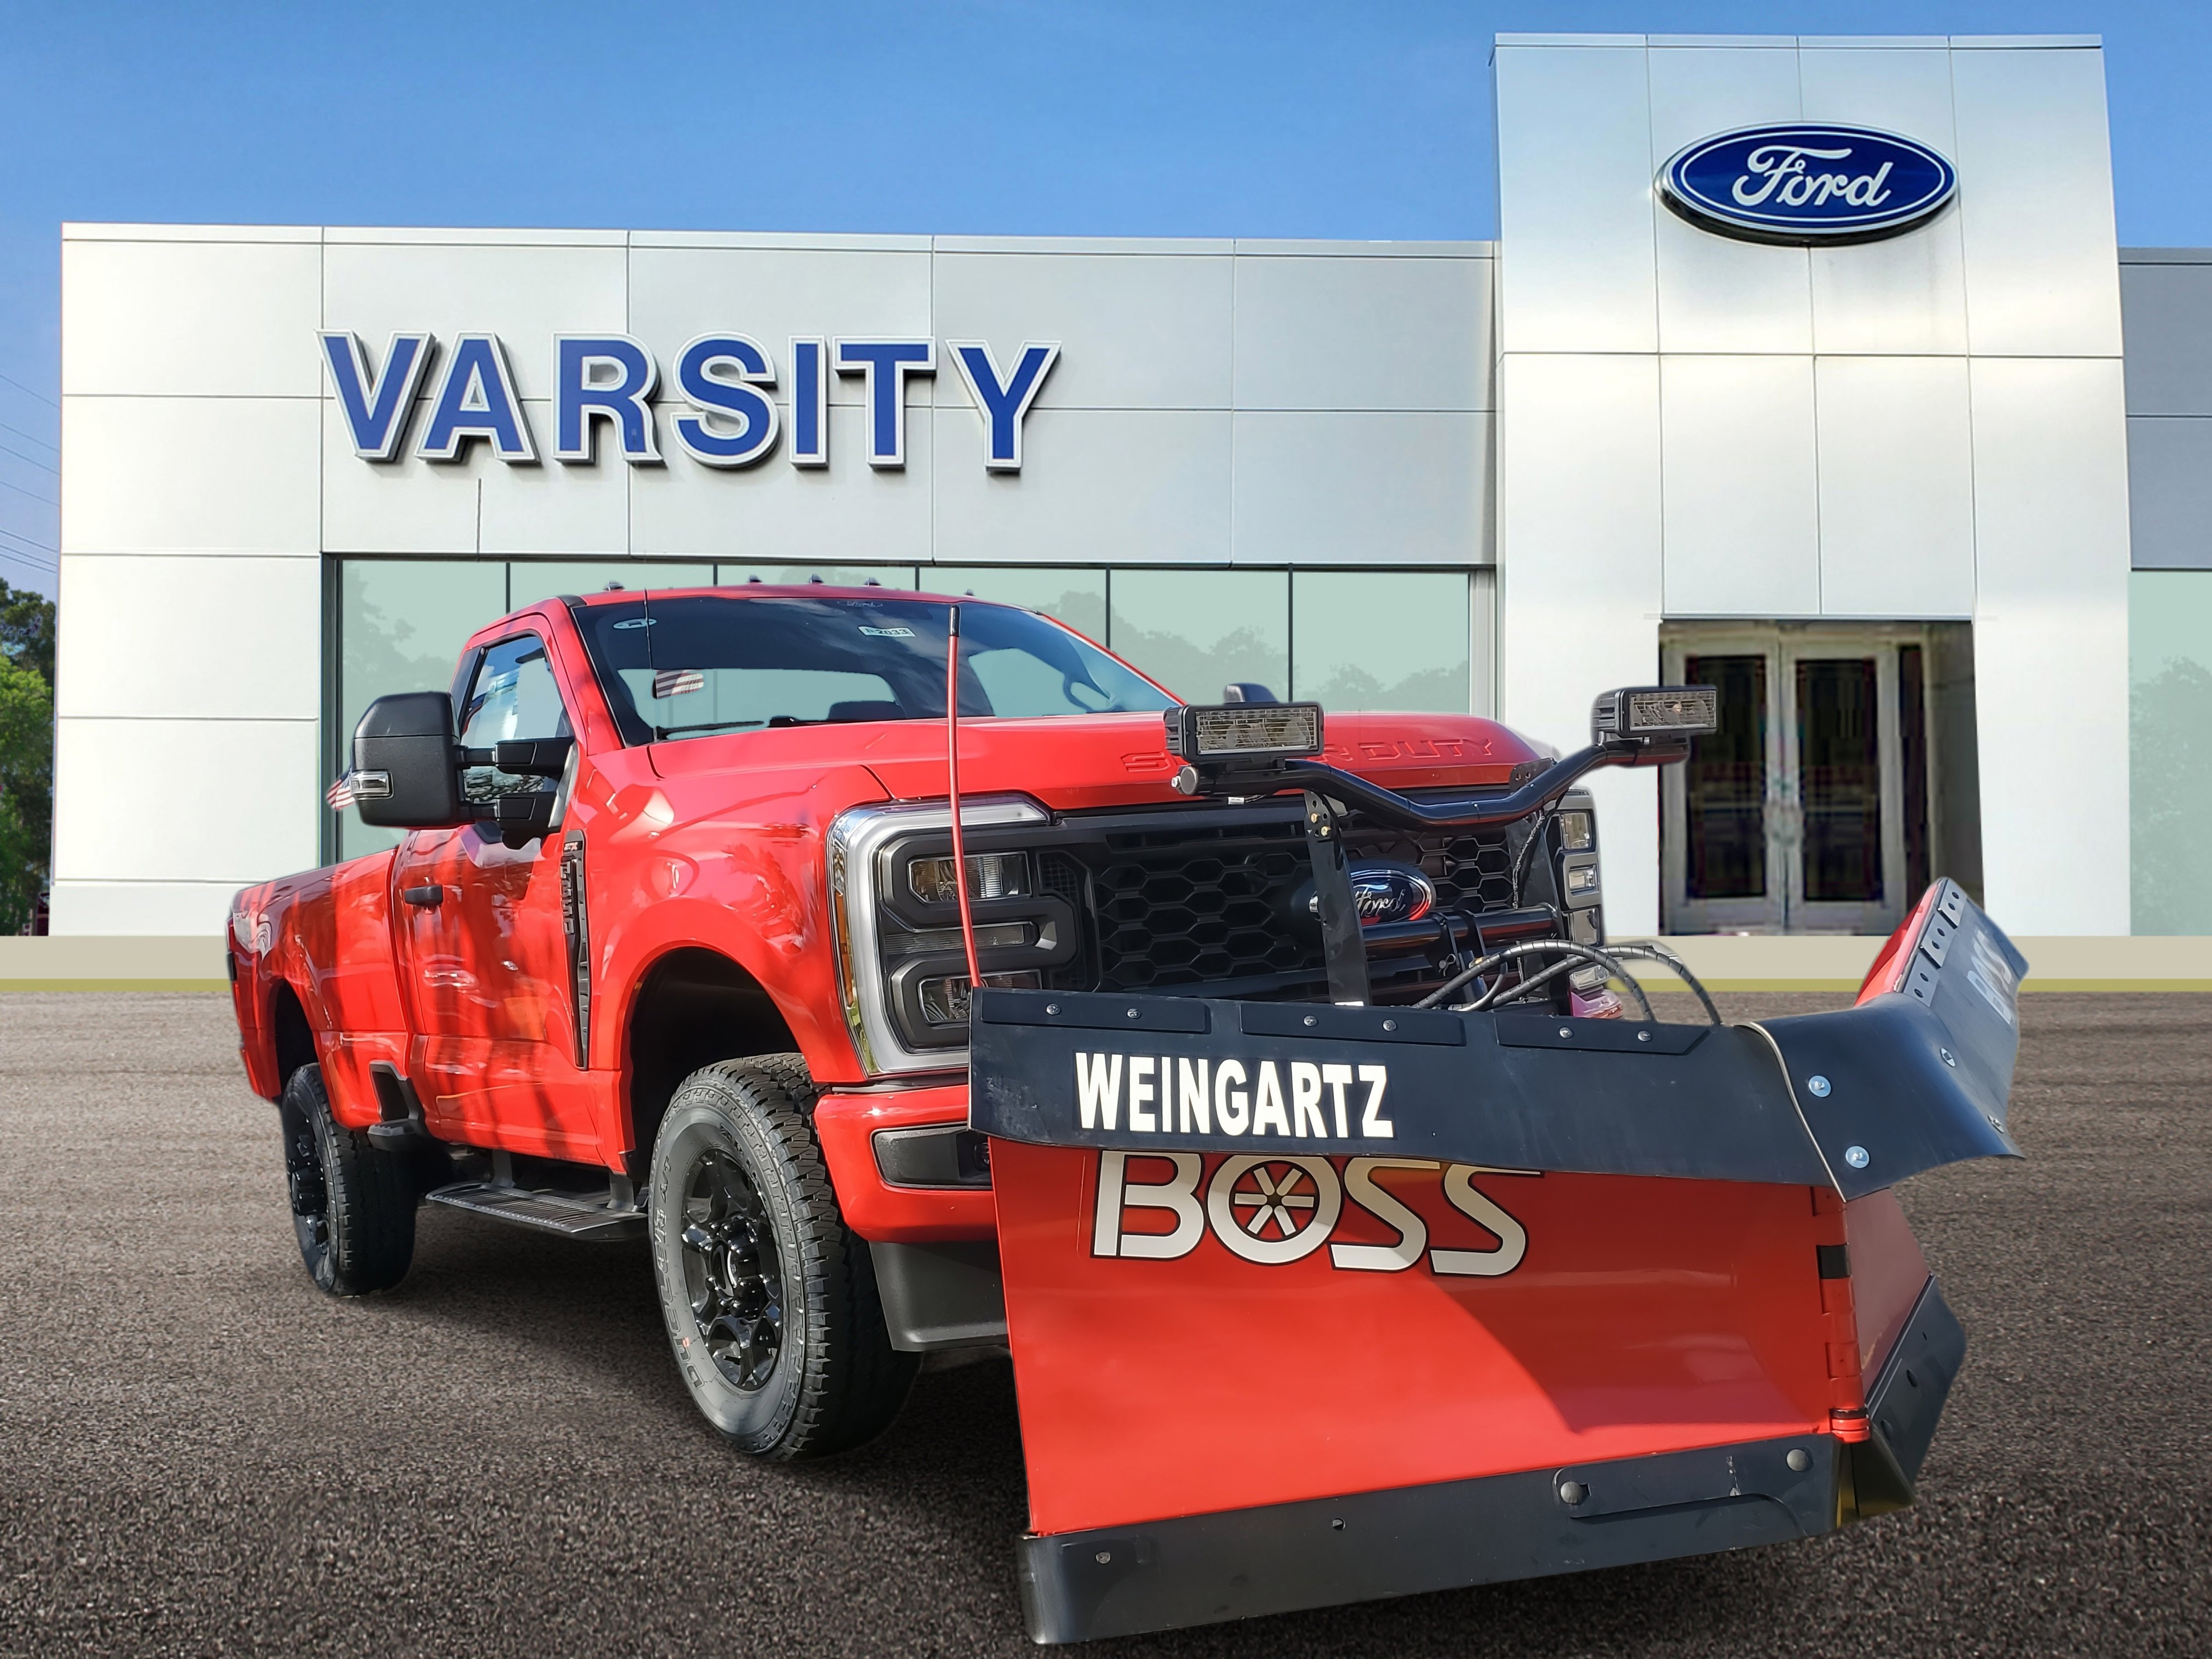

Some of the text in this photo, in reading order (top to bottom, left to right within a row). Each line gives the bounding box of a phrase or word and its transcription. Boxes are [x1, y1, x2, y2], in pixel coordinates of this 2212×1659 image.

[1732, 144, 1894, 207] Ford
[315, 330, 1063, 471] VARSITY
[1357, 738, 1492, 760] DUTY
[1353, 883, 1407, 918] Ford
[1075, 1052, 1394, 1138] WEINGARTZ
[1090, 1149, 1545, 1277] BOSS
